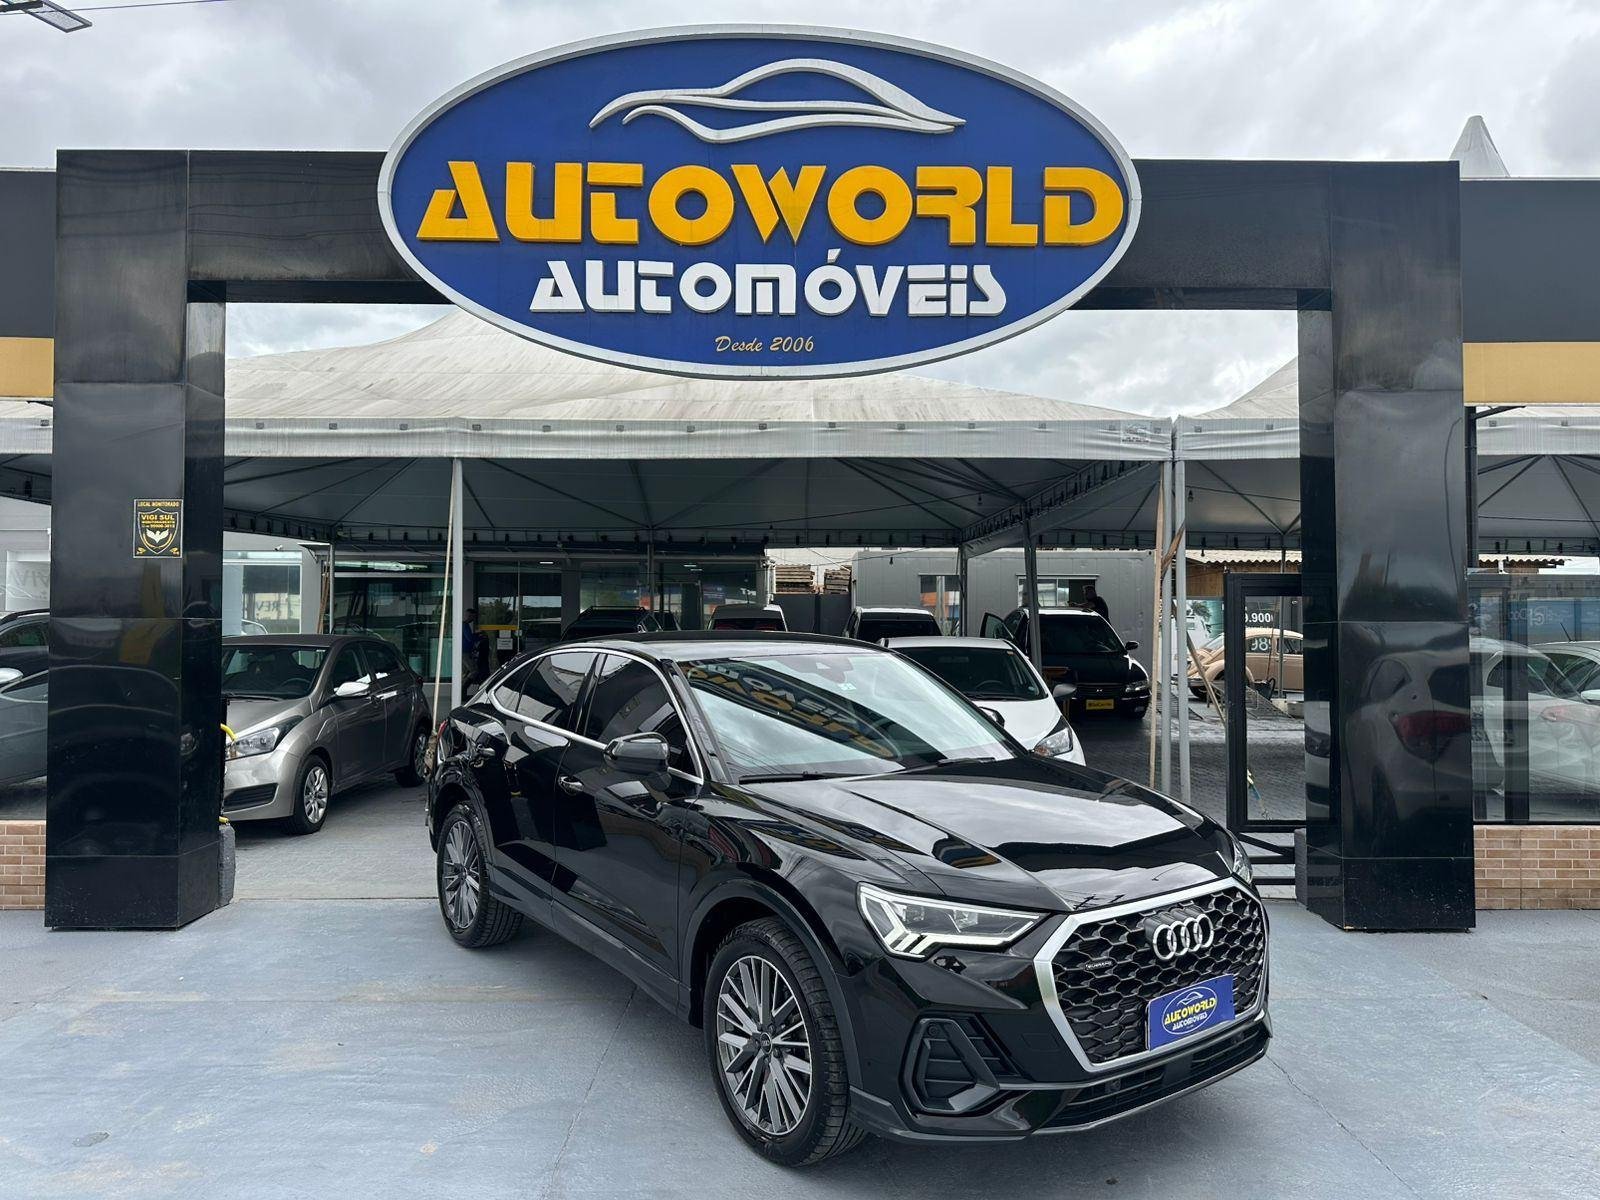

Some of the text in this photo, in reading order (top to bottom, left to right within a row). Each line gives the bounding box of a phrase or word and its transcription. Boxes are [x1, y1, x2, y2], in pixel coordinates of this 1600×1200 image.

[416, 160, 1124, 247] AUTOWORLD
[529, 248, 1007, 317] AUTOMÓVEIS
[715, 335, 815, 352] Desde 2006
[1165, 997, 1216, 1025] AUTOWORLD
